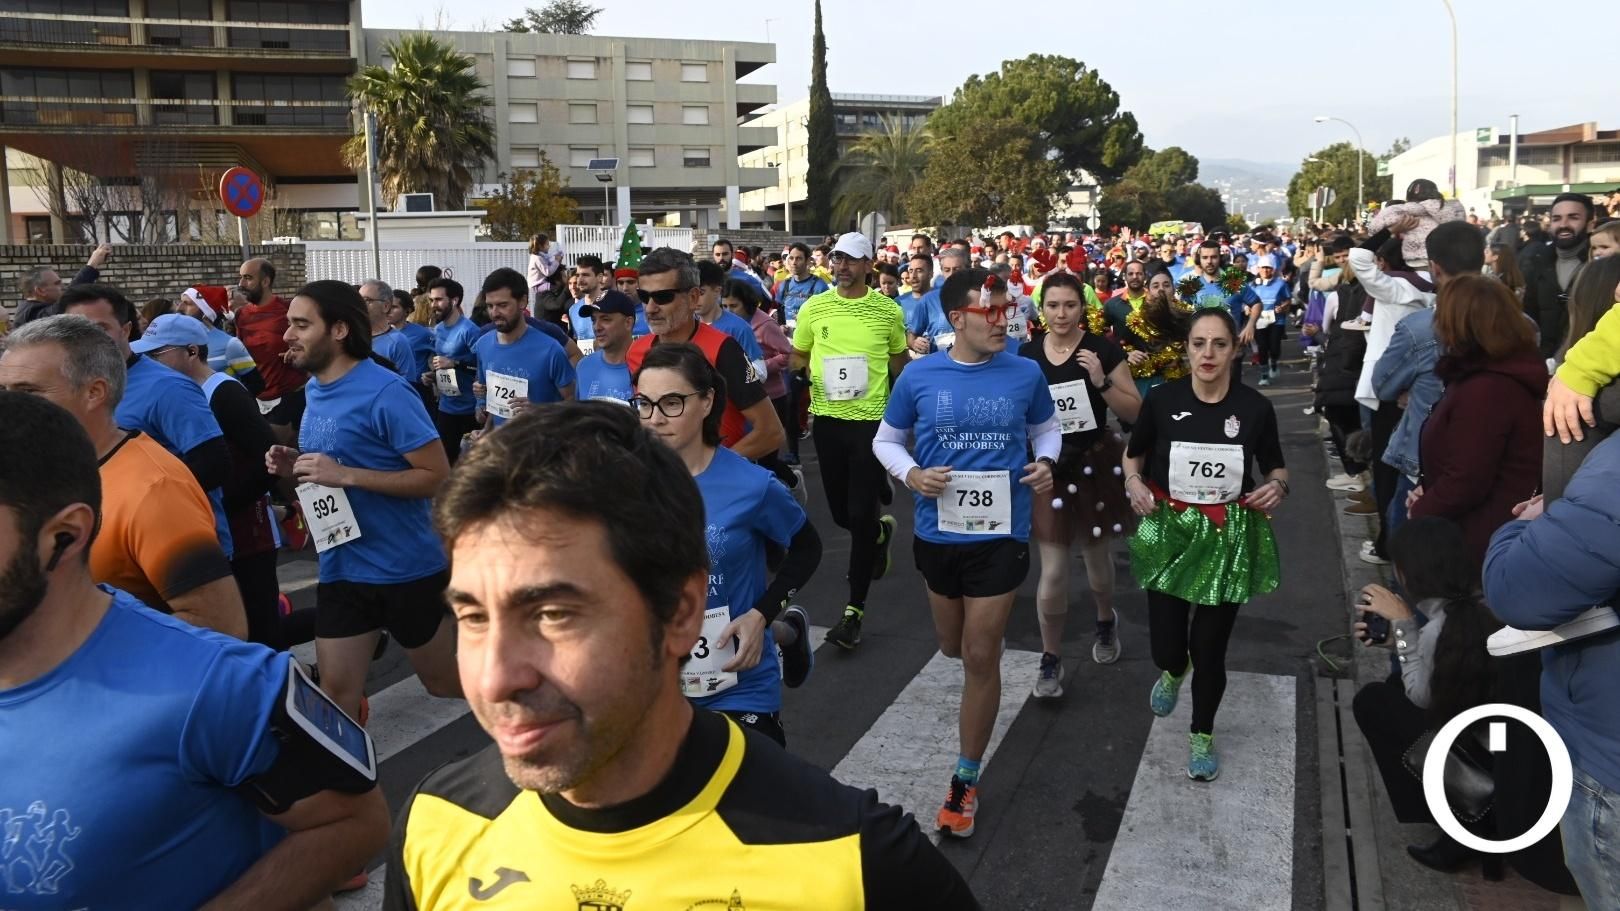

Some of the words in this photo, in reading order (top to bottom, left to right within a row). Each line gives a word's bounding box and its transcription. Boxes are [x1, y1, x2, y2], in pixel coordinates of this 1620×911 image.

[839, 367, 848, 381] 5
[494, 385, 516, 400] 724
[1053, 396, 1078, 412] 92
[937, 433, 957, 441] SAN
[959, 432, 1012, 441] SILVESTRE
[942, 441, 1006, 450] CORDOBESA
[1188, 460, 1226, 479] 762
[956, 489, 993, 507] 738
[312, 494, 339, 520] 592
